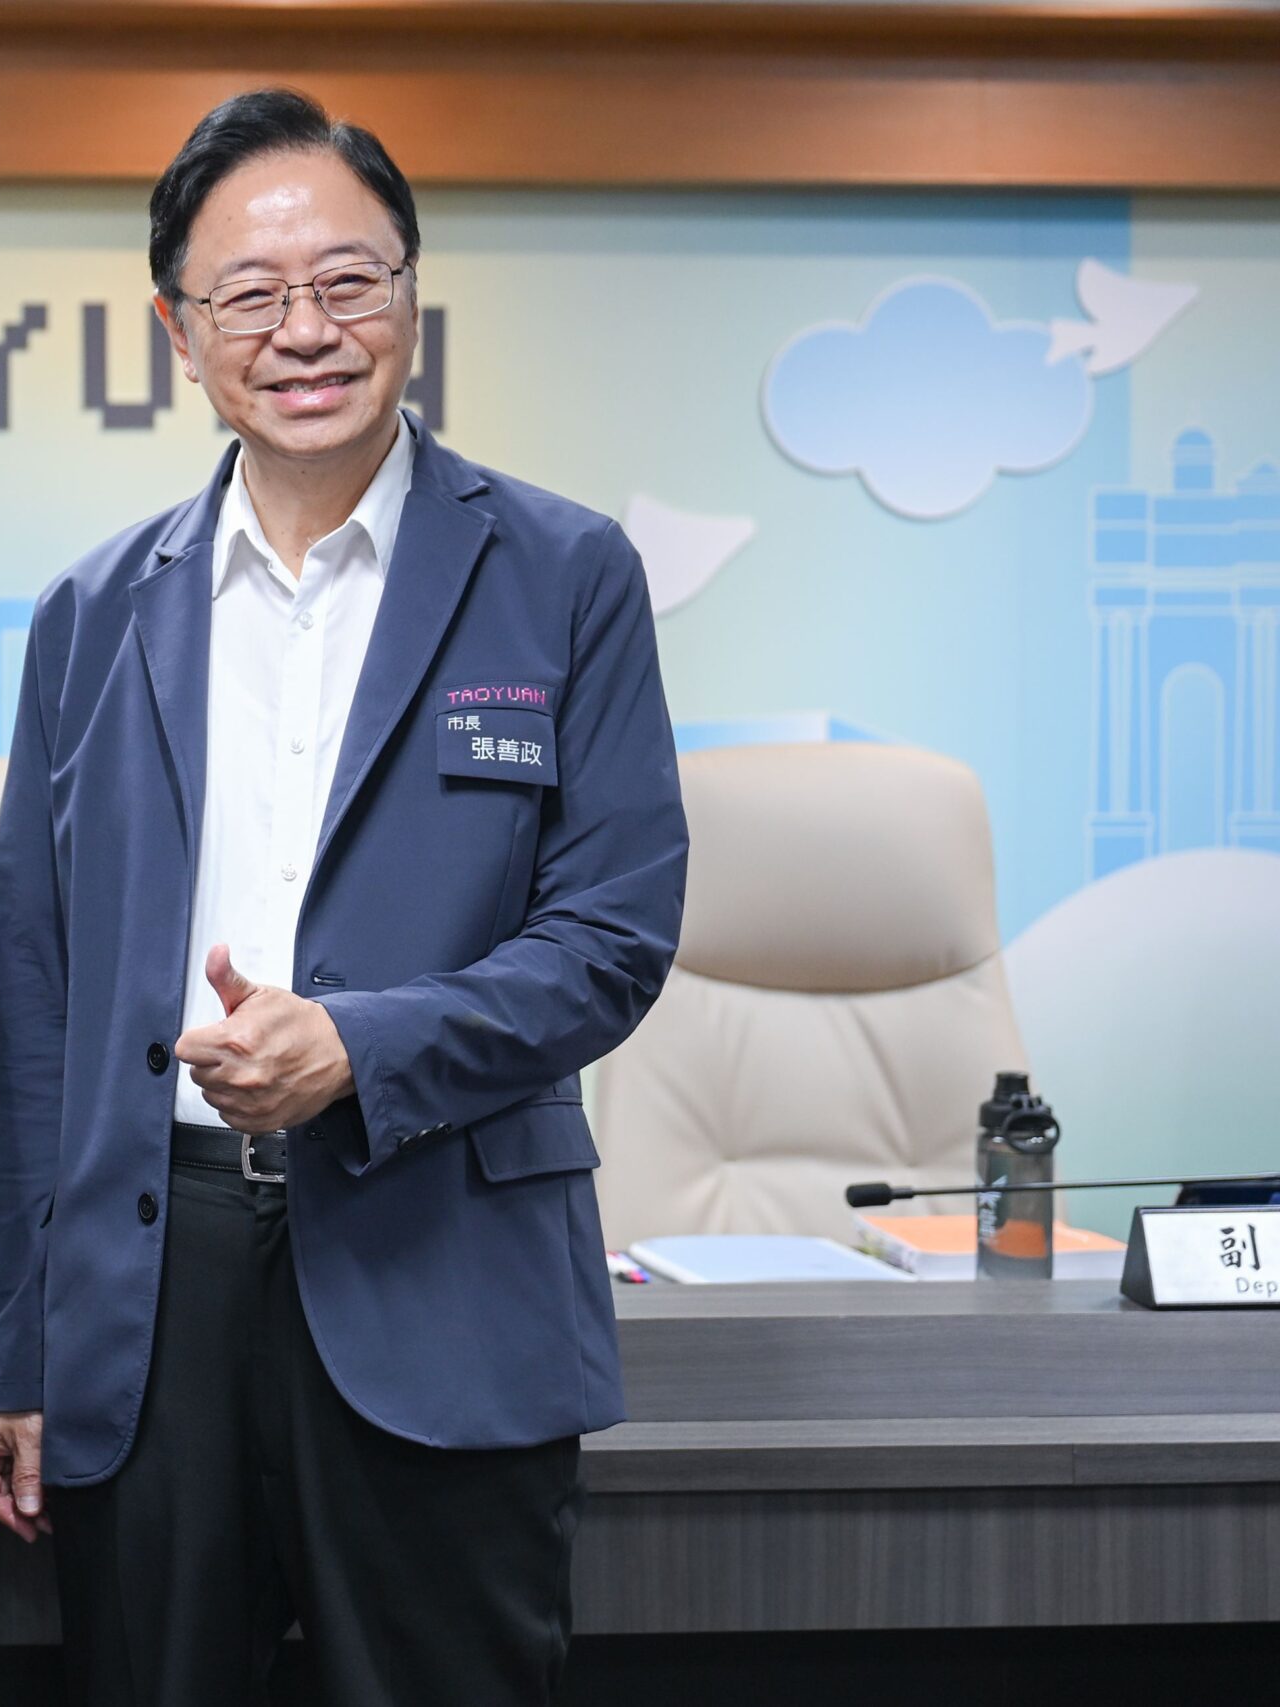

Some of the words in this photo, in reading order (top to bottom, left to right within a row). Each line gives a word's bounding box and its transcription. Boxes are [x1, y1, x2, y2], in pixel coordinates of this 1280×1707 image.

[447, 687, 547, 706] TAOYUAN
[447, 715, 482, 731] 市長
[471, 736, 543, 767] 張善政
[1220, 1223, 1261, 1271] 副
[1235, 1276, 1279, 1299] Dep
